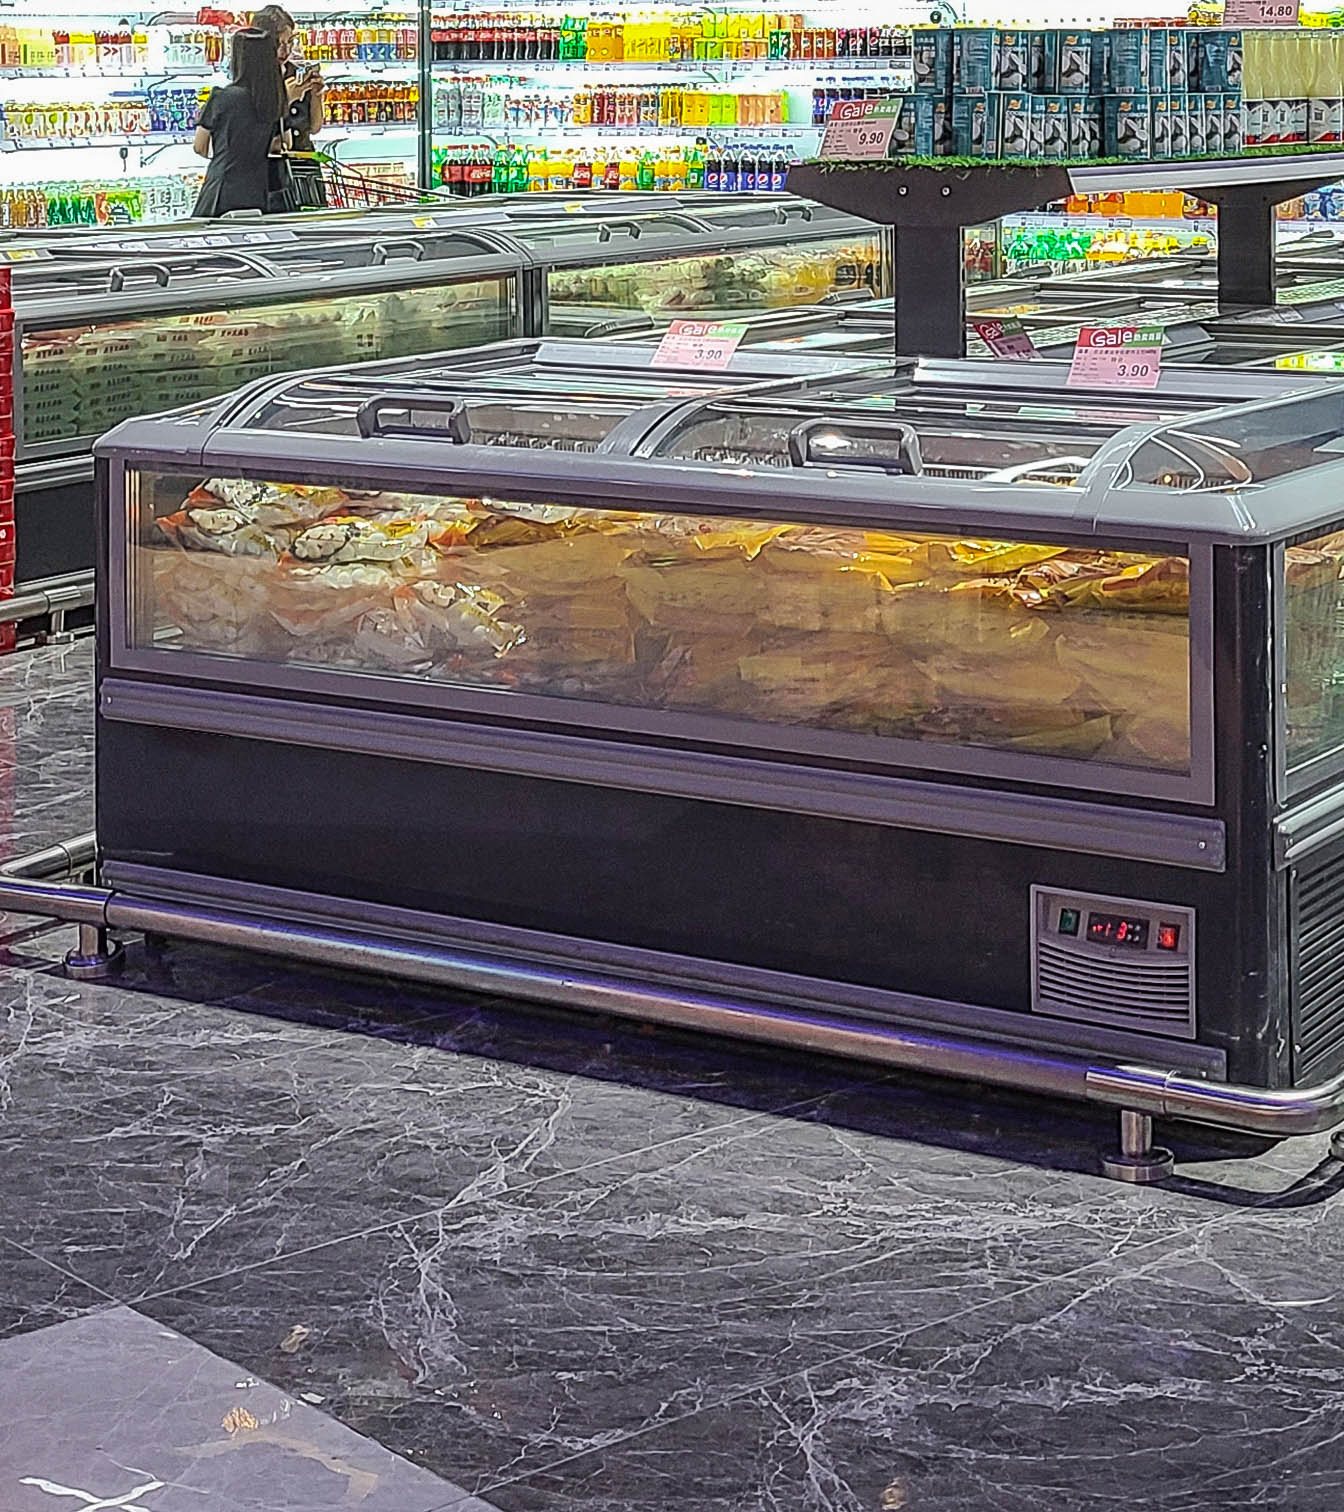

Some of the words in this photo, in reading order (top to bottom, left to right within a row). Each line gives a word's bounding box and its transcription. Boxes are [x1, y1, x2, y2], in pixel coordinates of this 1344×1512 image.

[1259, 6, 1293, 17] 14.80
[859, 132, 884, 145] 9.90
[694, 349, 723, 360] 3.90
[1117, 365, 1149, 377] 3.90
